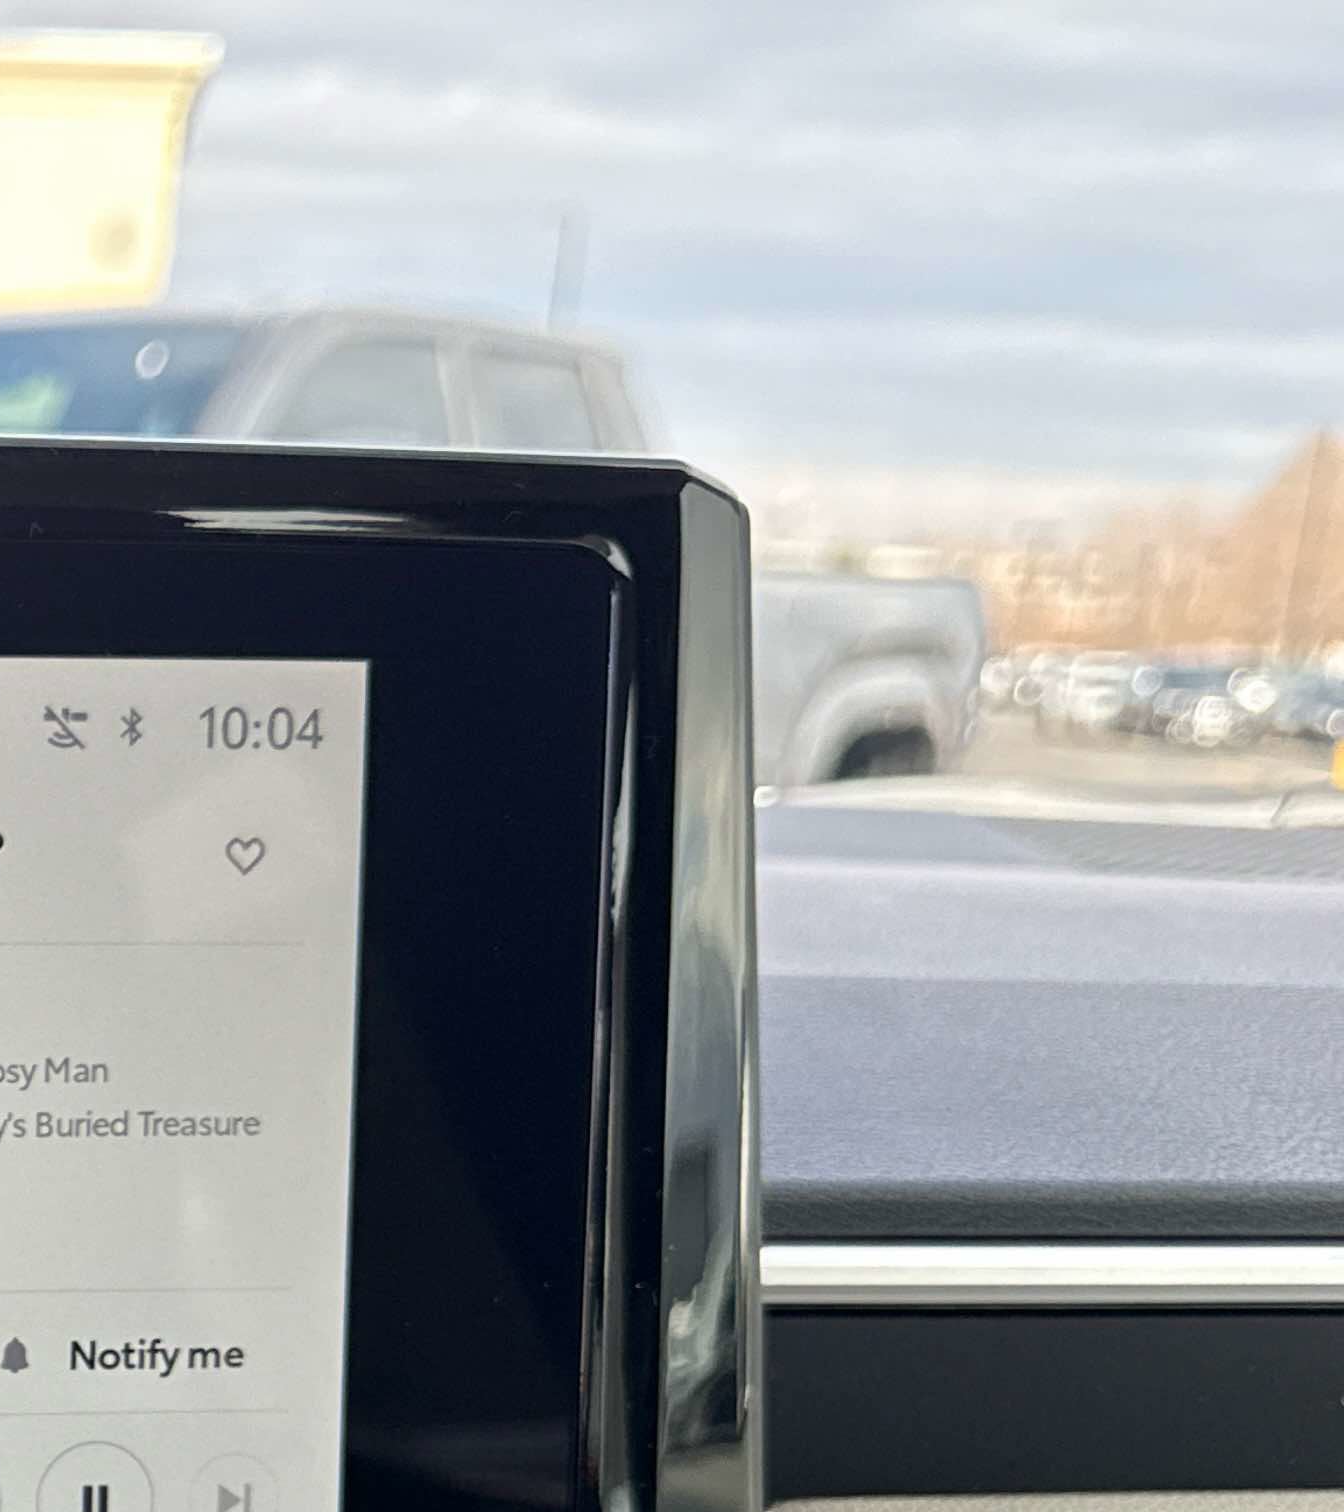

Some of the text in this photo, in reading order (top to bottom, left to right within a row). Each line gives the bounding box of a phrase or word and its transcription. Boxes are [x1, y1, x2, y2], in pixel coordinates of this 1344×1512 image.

[200, 706, 324, 751] 10:04
[44, 1059, 109, 1084] Man
[36, 1111, 130, 1138] Buried
[138, 1111, 261, 1137] Treasure
[69, 1339, 245, 1378] Notify me
